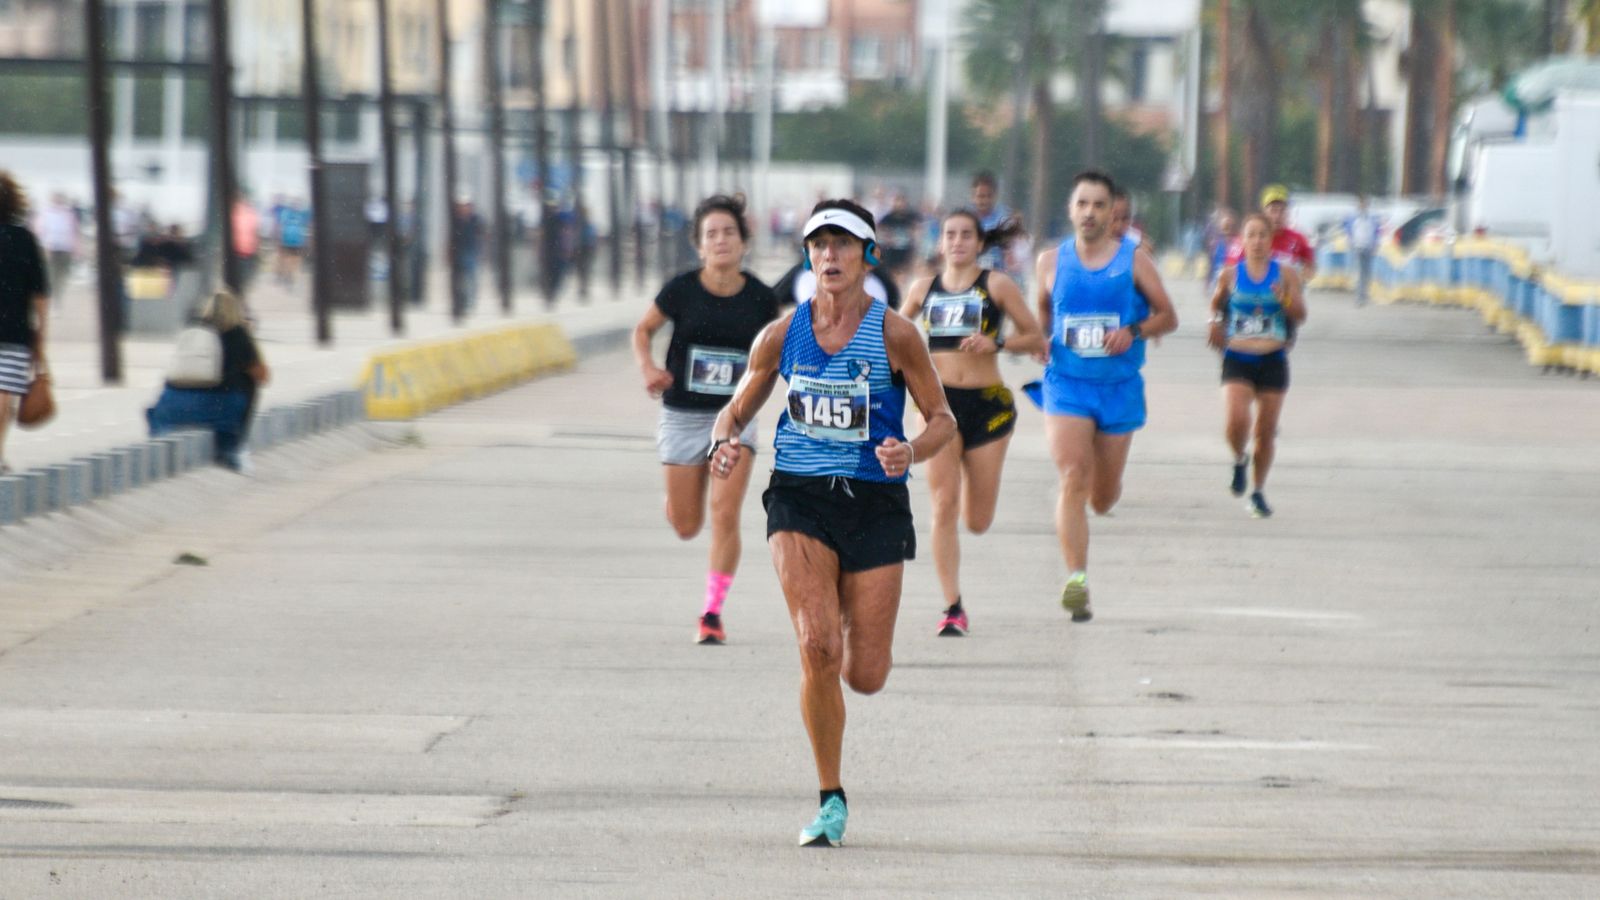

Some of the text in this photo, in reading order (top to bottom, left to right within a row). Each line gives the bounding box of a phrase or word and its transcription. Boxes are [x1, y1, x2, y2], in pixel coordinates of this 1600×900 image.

[943, 305, 966, 327] 72
[1077, 326, 1105, 349] 60
[705, 363, 734, 386] 29
[800, 394, 852, 429] 145
